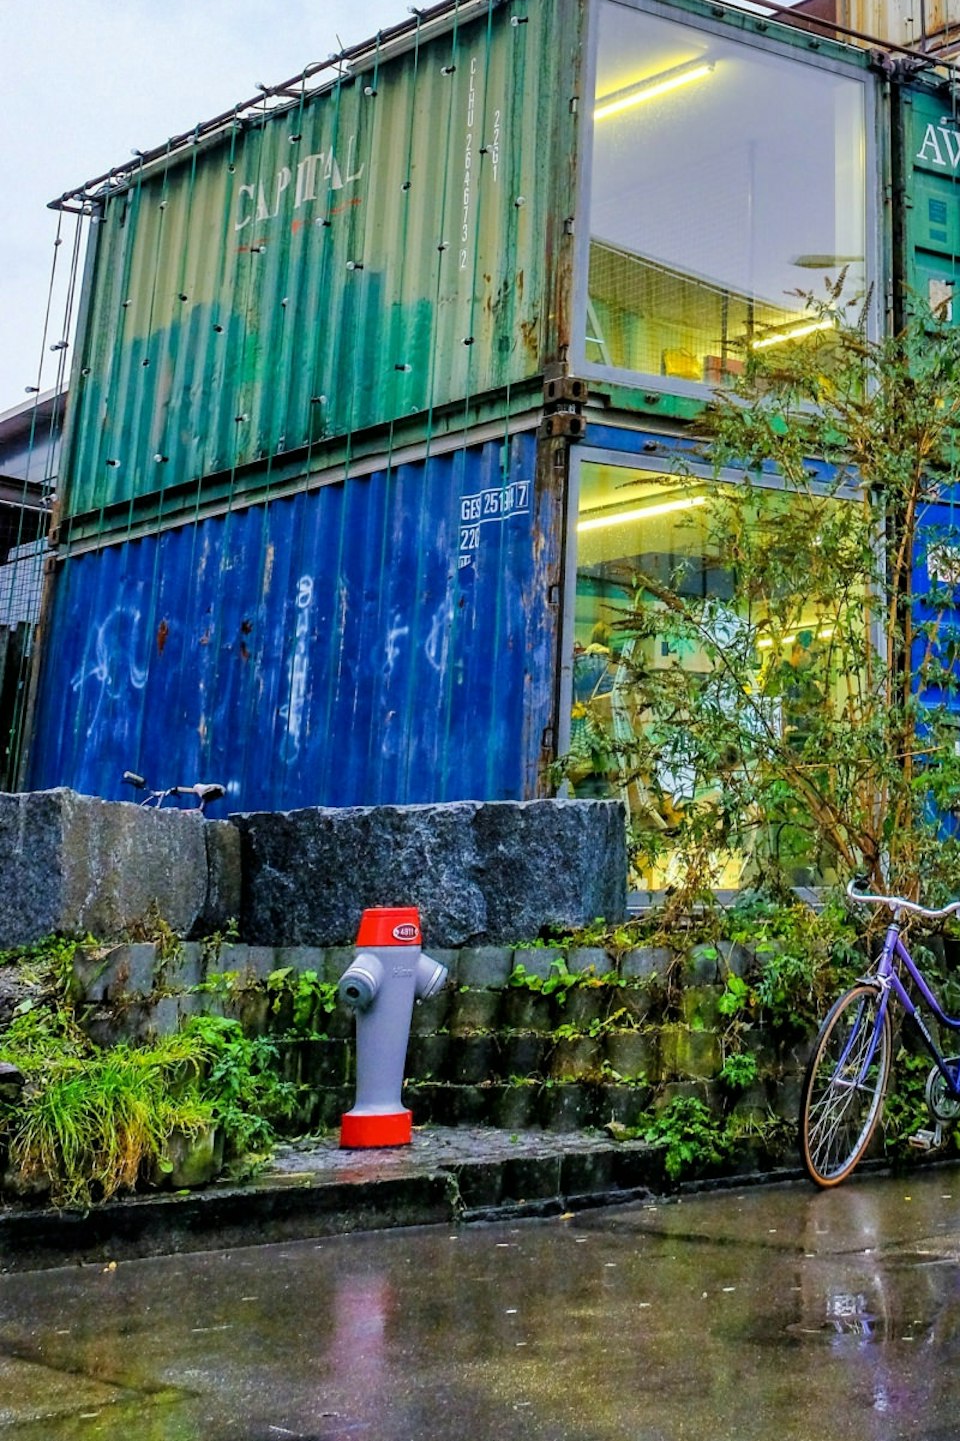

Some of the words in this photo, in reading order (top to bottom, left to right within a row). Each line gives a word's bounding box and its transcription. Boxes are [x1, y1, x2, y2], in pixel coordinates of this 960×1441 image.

[468, 58, 476, 127] CLHU
[235, 136, 365, 231] CAPITAL
[491, 110, 501, 182] 22G1
[461, 134, 472, 242] 264673
